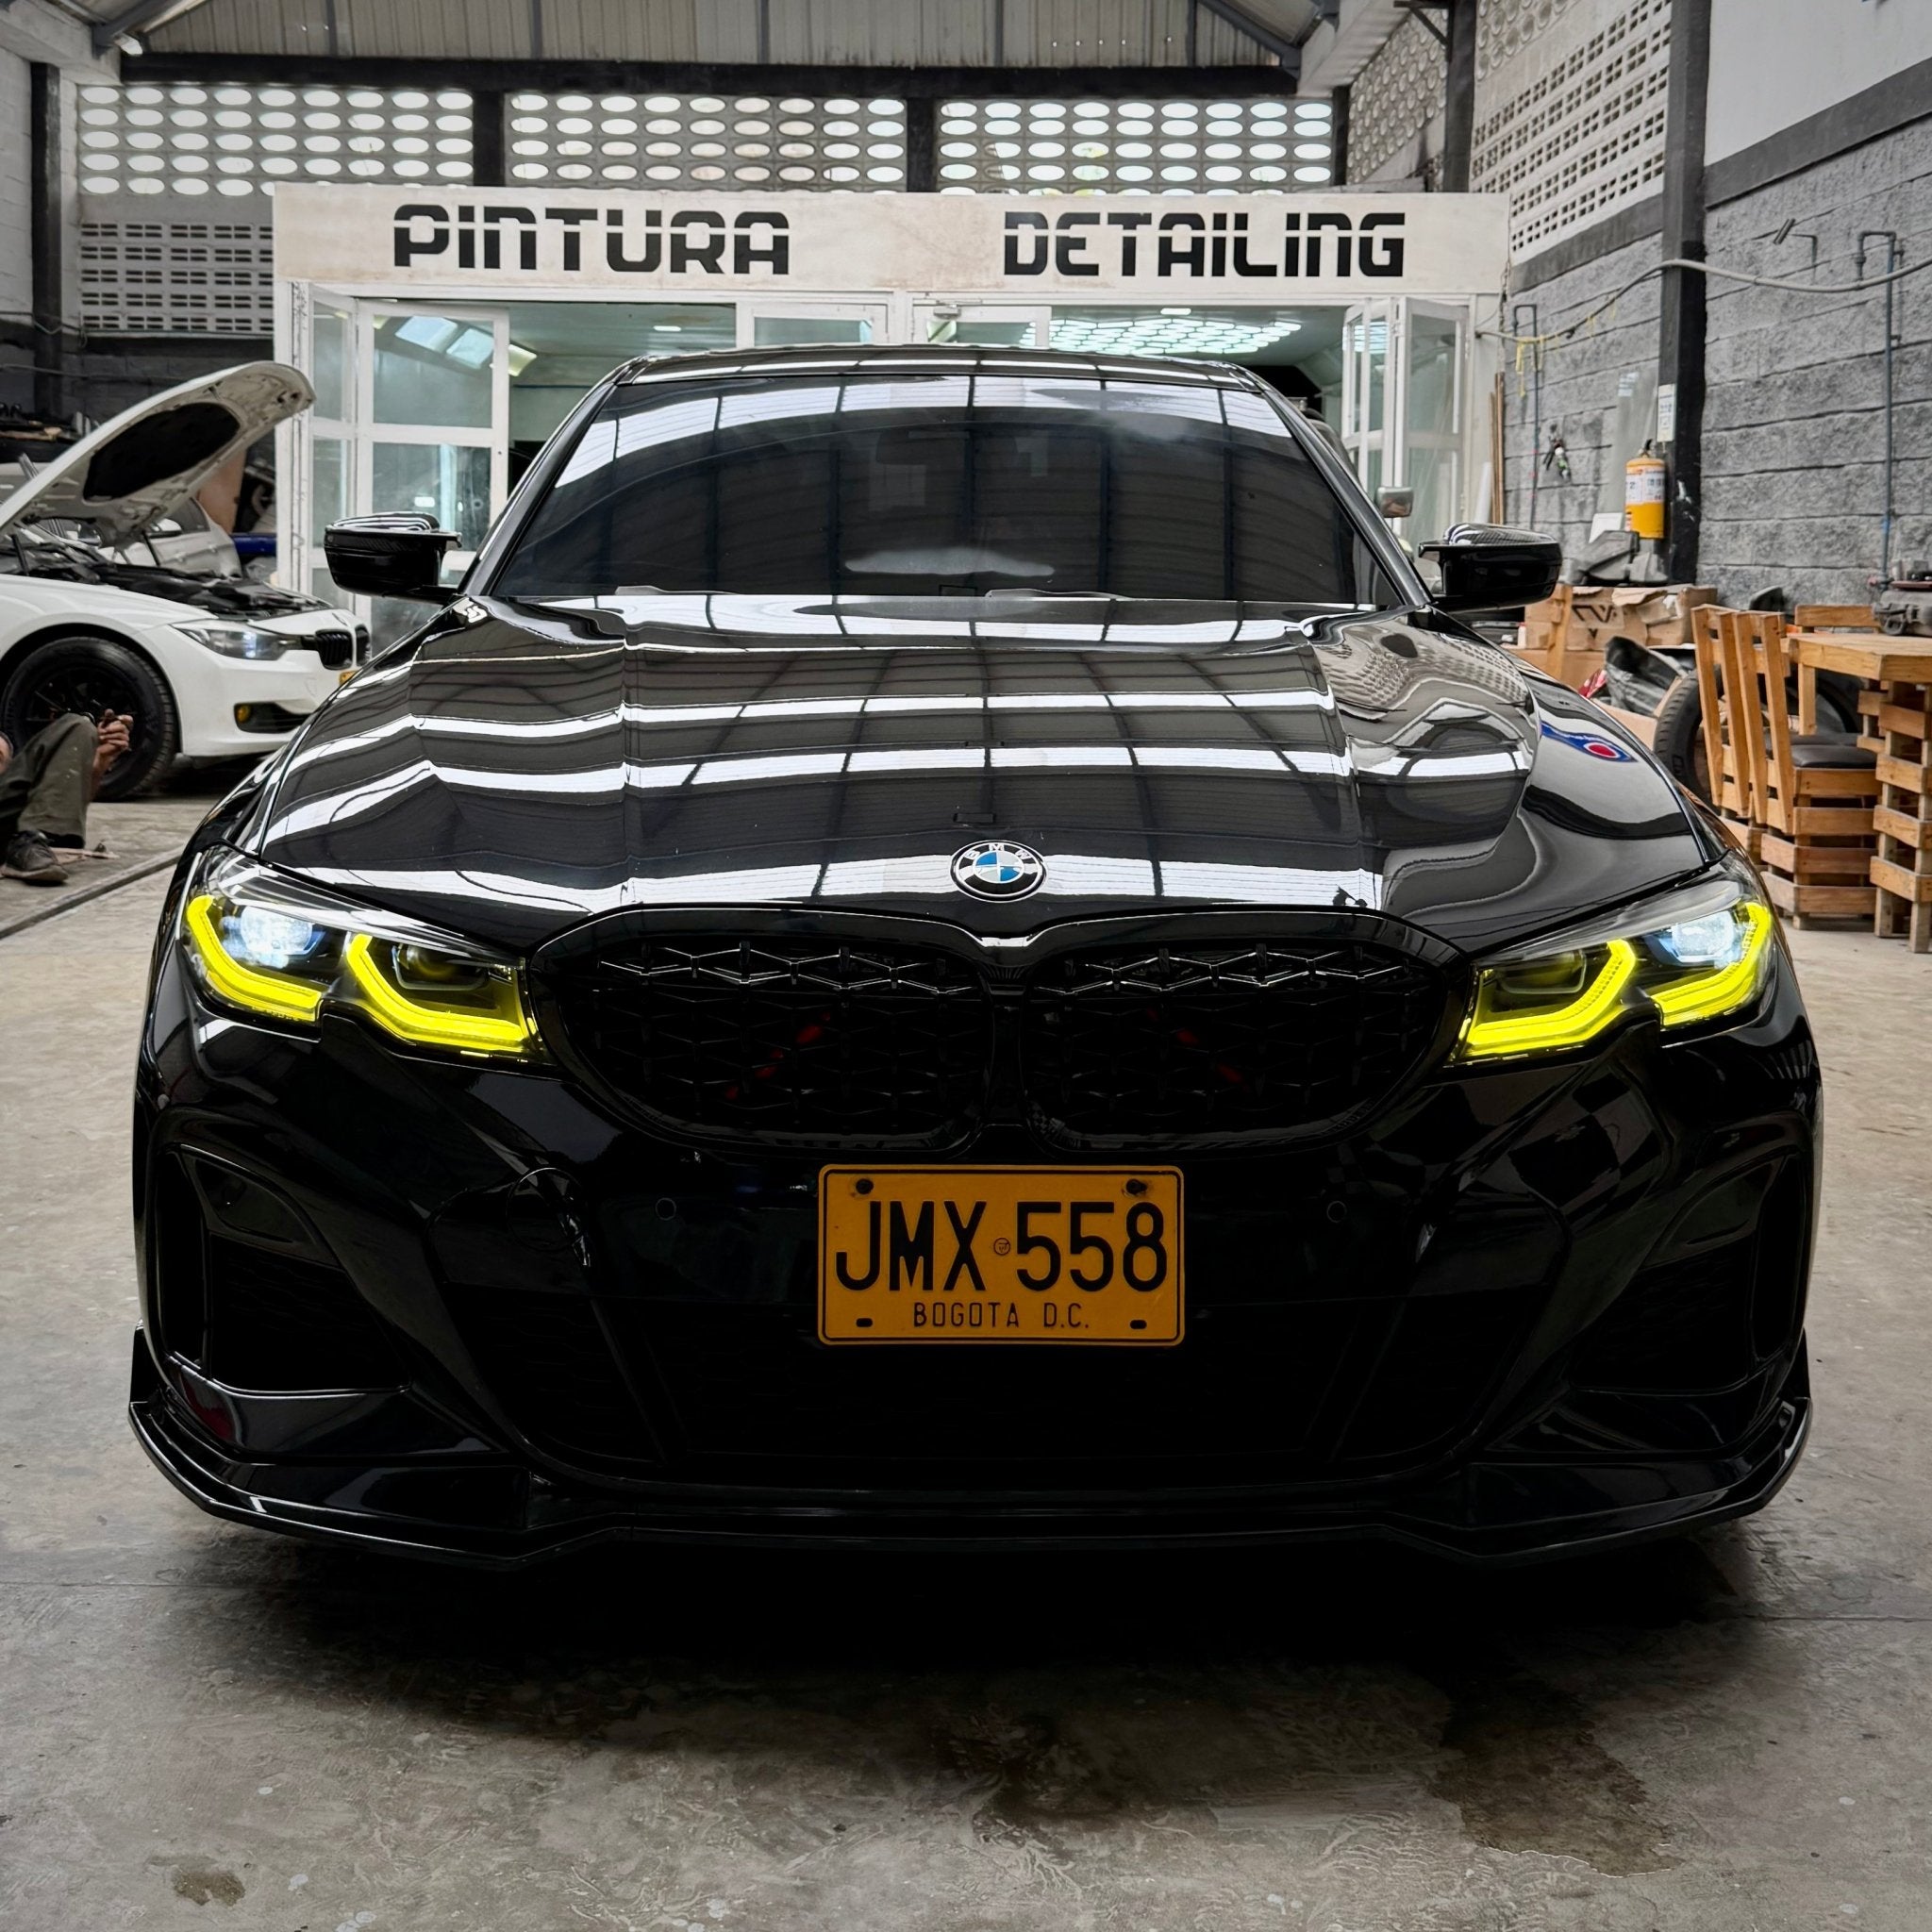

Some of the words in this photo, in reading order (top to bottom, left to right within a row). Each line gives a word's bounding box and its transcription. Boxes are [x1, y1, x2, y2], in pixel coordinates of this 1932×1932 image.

[394, 204, 789, 275] PINTURA
[1004, 212, 1406, 276] DETAILING
[836, 1201, 987, 1291] JMX
[1016, 1201, 1168, 1292] 558
[913, 1302, 1019, 1328] BOGOTA
[1043, 1303, 1089, 1328] D.C.
